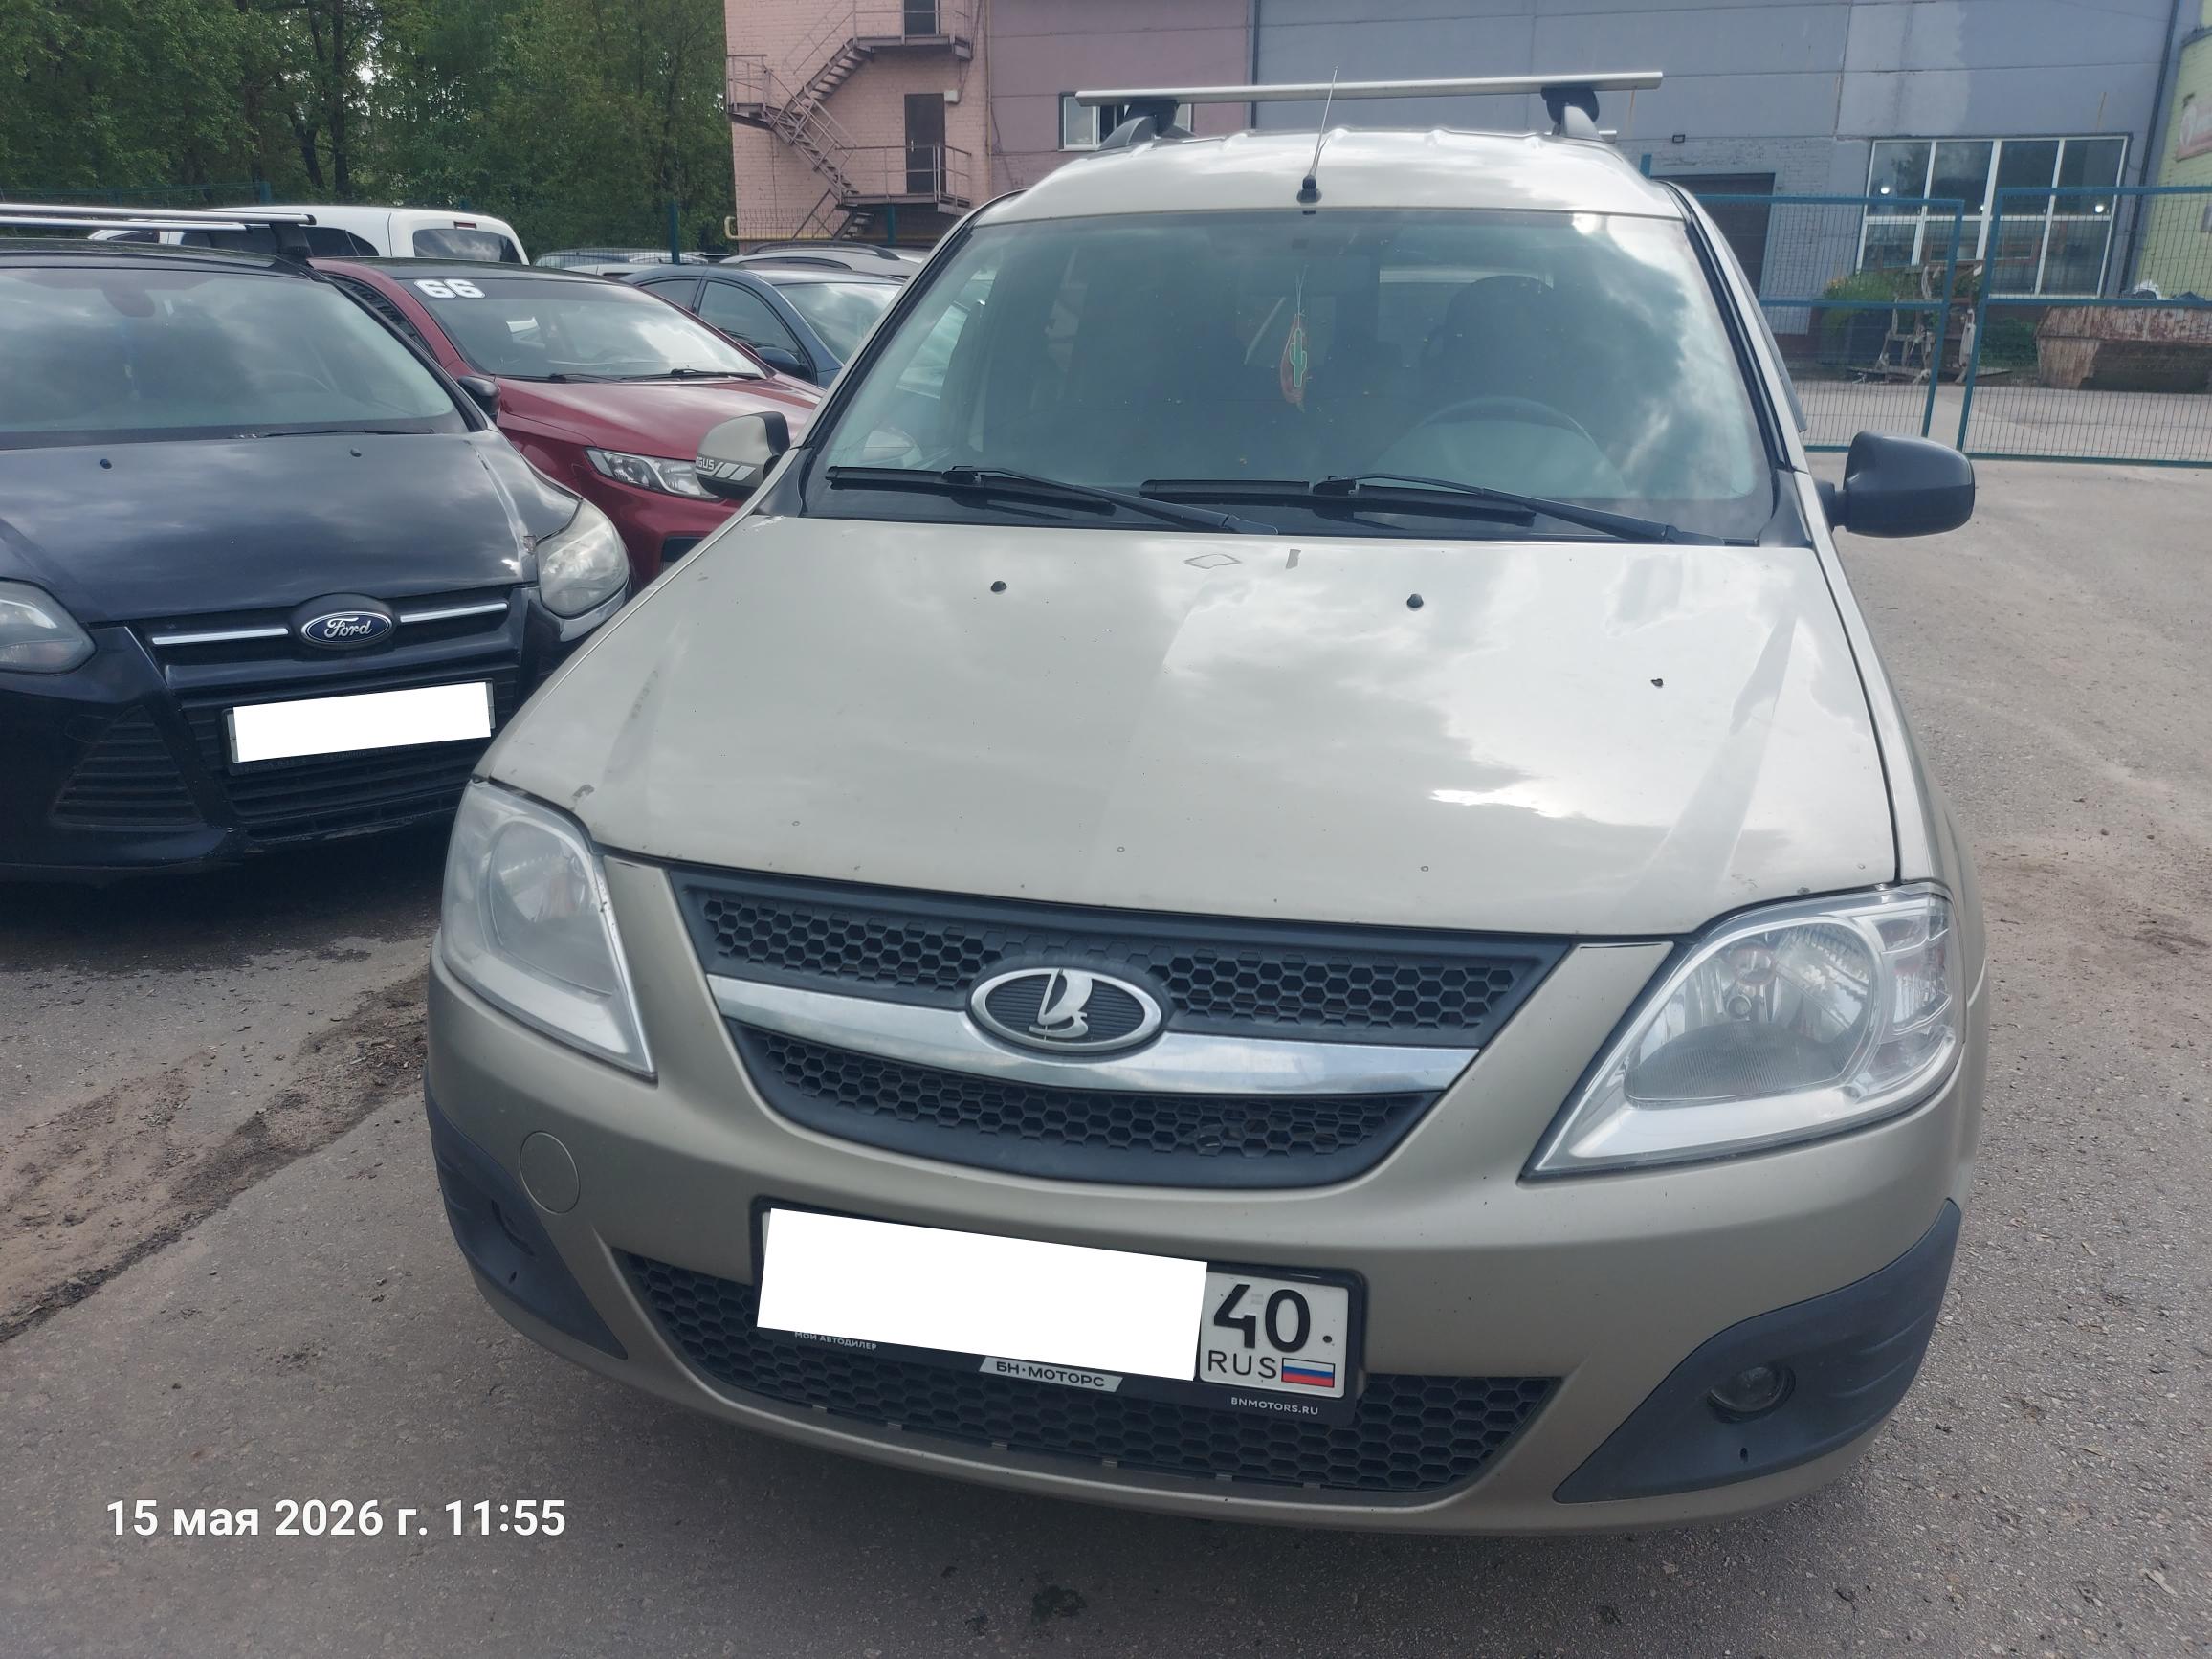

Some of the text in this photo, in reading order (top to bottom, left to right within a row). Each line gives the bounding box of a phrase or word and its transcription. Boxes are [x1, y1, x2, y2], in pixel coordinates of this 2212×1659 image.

[414, 278, 486, 299] 66
[324, 617, 373, 638] Ford
[1213, 1283, 1311, 1353] 40
[819, 1335, 877, 1350] АВТОДИЛЕР
[1207, 1349, 1277, 1379] RUS
[1230, 1397, 1319, 1415] BNMOTORS.RU
